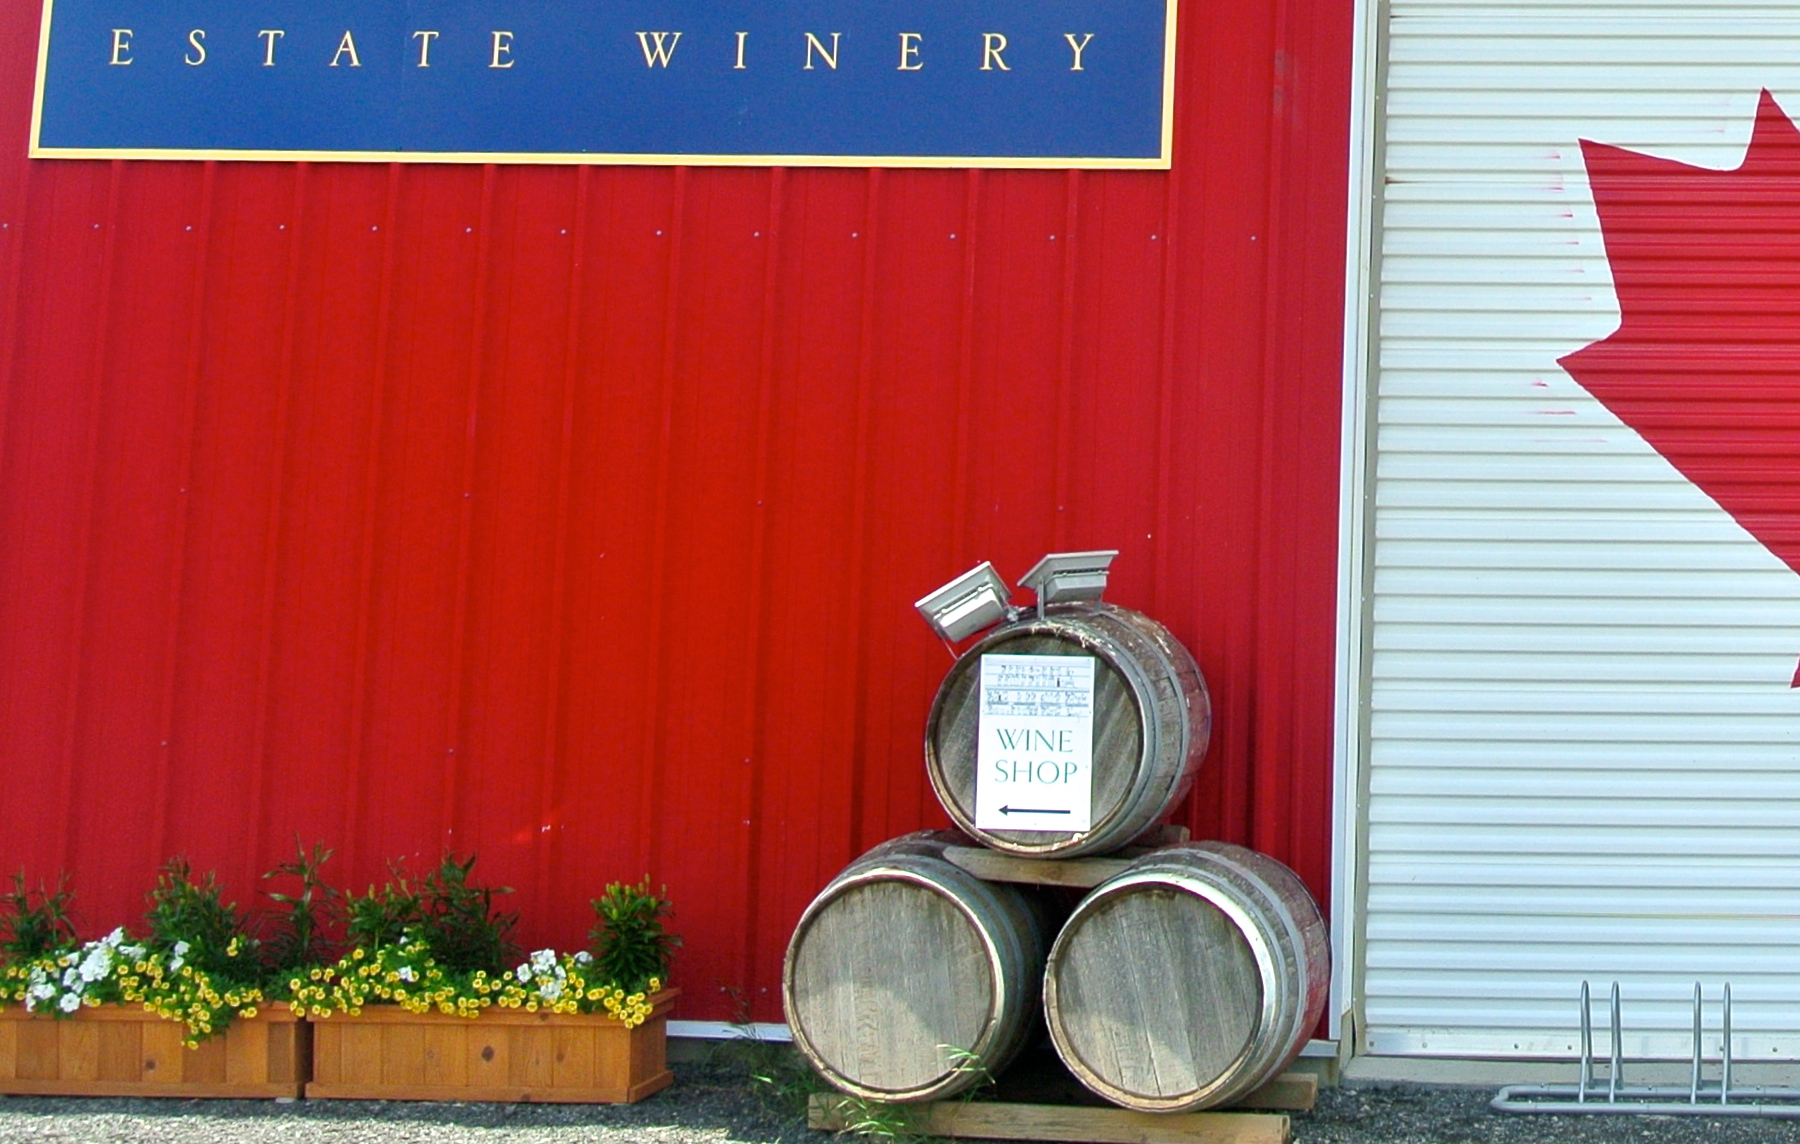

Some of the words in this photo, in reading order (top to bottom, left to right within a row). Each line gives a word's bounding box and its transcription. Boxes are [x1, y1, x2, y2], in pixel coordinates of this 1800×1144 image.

[109, 28, 515, 69] ESTATE
[635, 30, 1095, 72] WINERY
[996, 728, 1074, 753] WINE
[995, 759, 1078, 785] SHOP
